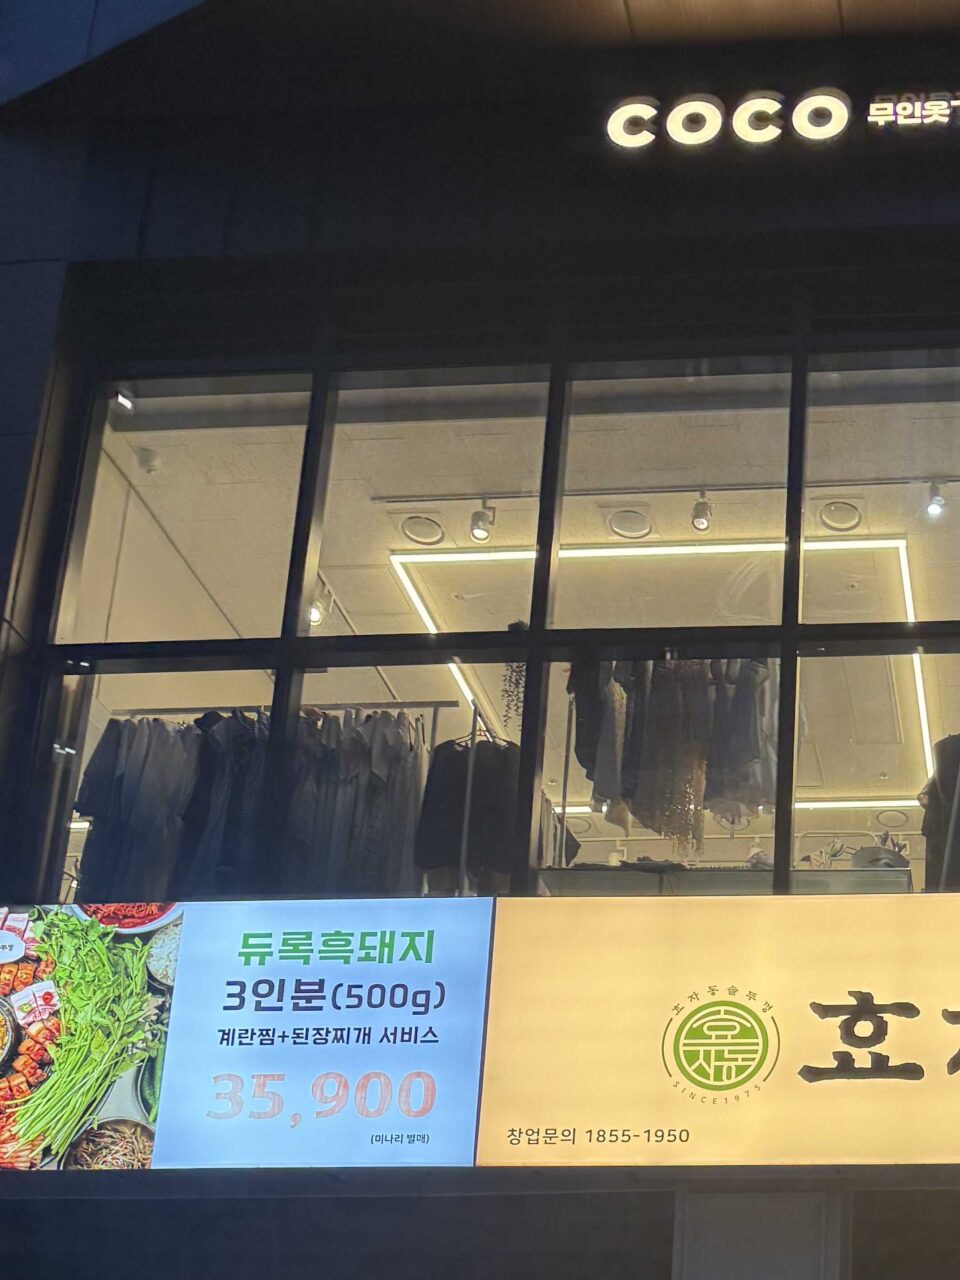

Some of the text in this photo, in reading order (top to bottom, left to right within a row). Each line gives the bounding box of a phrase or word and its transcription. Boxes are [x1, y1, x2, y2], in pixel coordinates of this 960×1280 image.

[606, 94, 850, 147] COCO
[237, 930, 435, 966] 듀록흑돼지
[222, 977, 446, 1015] 3인분(500g)
[217, 1026, 440, 1046] 계란찜+된장찌개 서비스
[205, 1071, 437, 1129] 35,900
[507, 1127, 691, 1145] 창업문의 1855-1950
